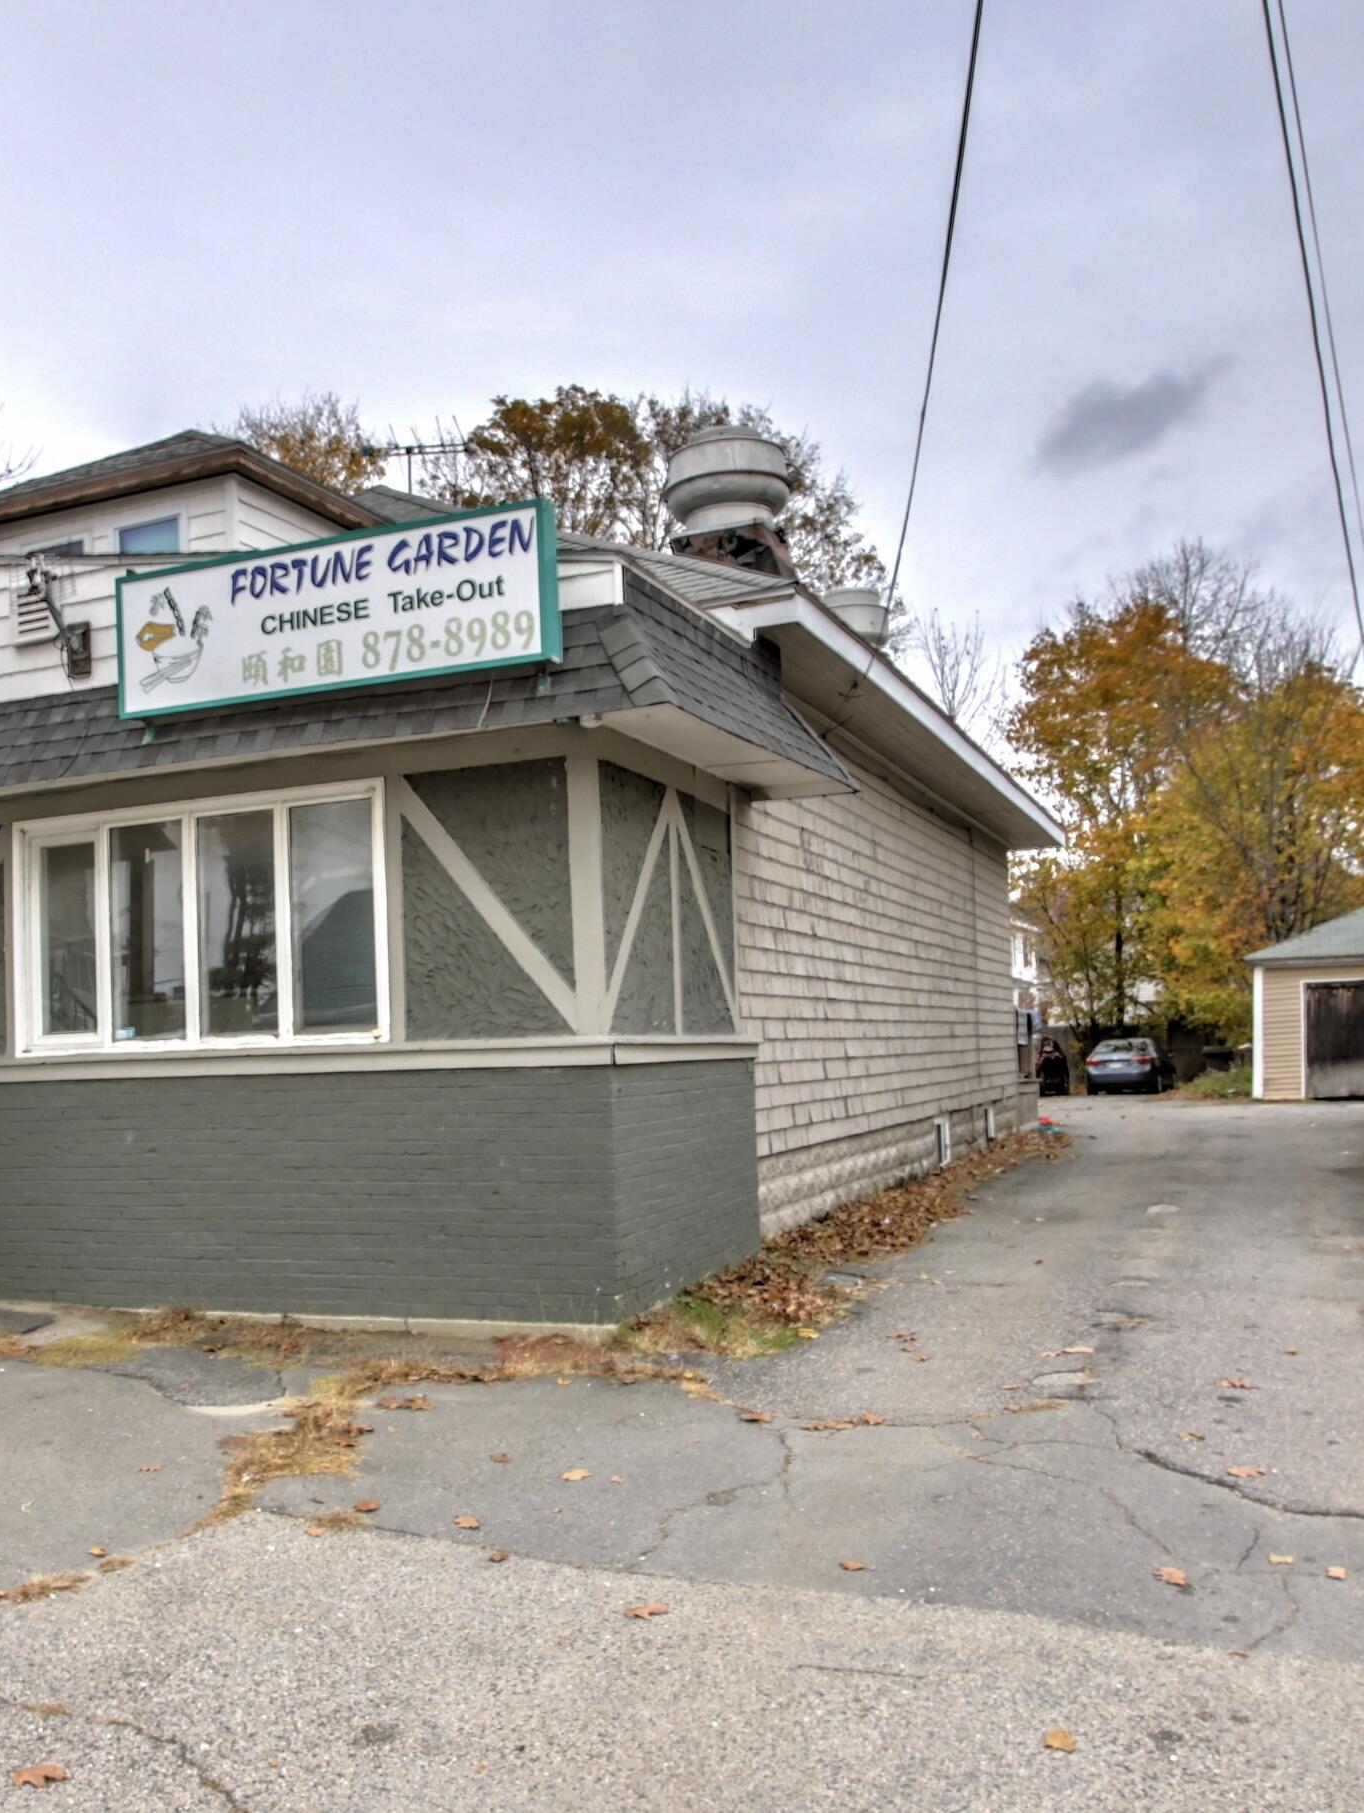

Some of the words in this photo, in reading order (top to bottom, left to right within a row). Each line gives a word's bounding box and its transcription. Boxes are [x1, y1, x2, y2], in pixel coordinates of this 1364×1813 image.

[230, 544, 375, 606] FORTUNE
[386, 516, 536, 577] GARDEN
[260, 598, 371, 636] CHINESE
[387, 574, 506, 615] Take-Out
[361, 609, 536, 672] 878-8989
